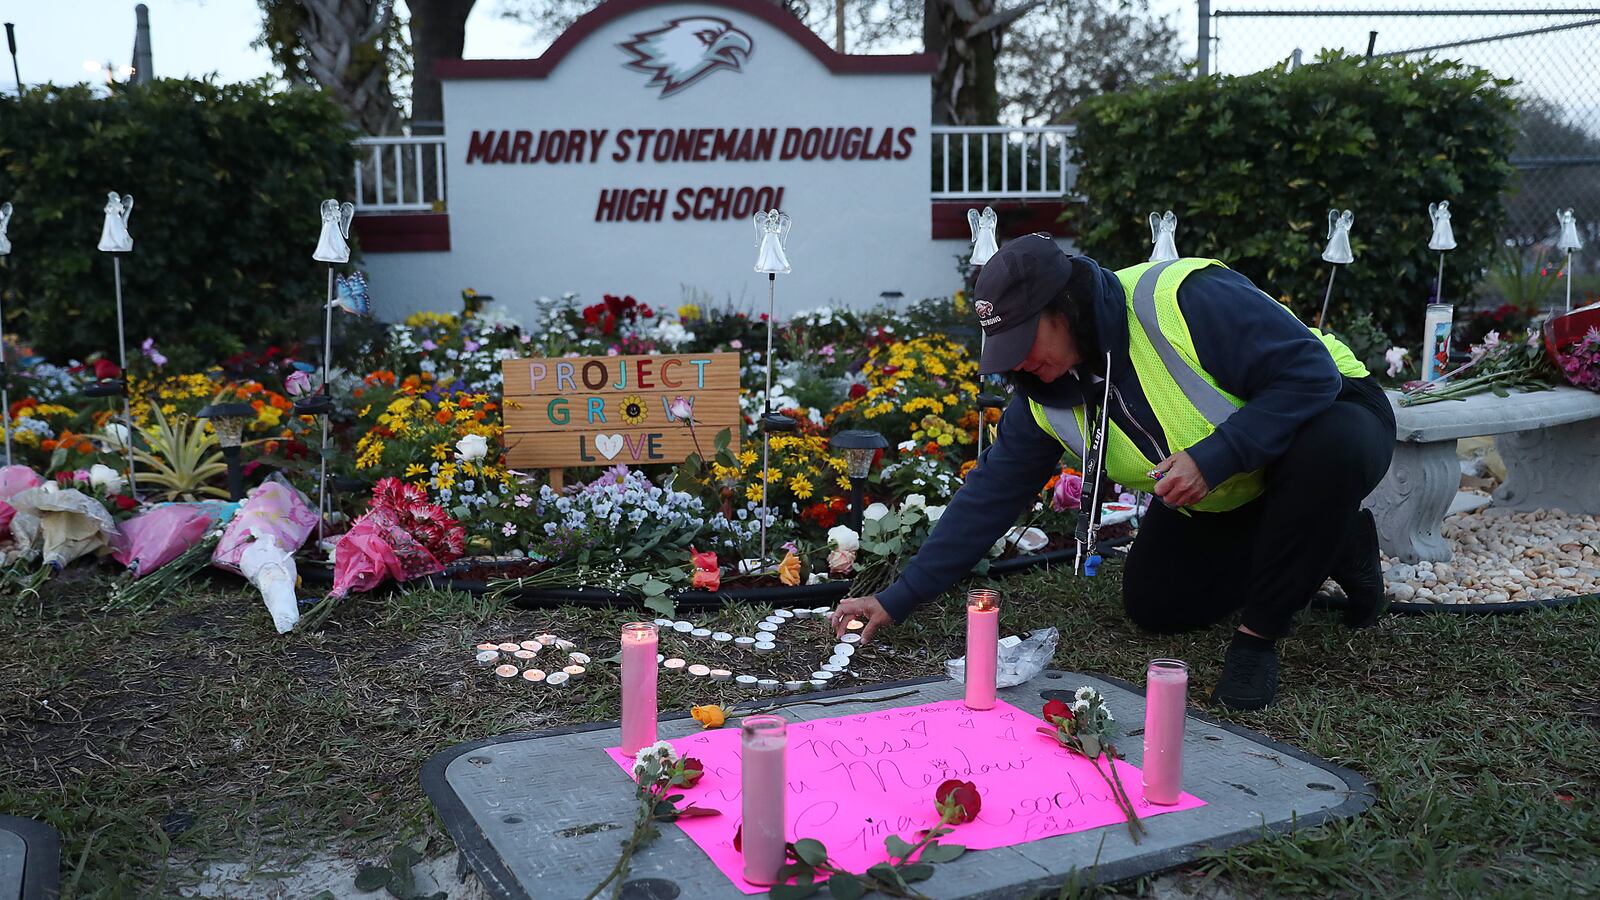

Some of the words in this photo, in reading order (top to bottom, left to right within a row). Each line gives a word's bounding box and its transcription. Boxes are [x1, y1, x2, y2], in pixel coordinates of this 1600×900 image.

[466, 129, 607, 165] MARJORY
[612, 128, 779, 163] STONEMAN
[780, 127, 916, 161] DOUGLAS
[596, 188, 669, 223] HIGH
[529, 359, 712, 391] PROJECT
[1092, 428, 1103, 451] JETS
[820, 746, 1033, 793] Meadow
[1023, 816, 1087, 840] Feis
